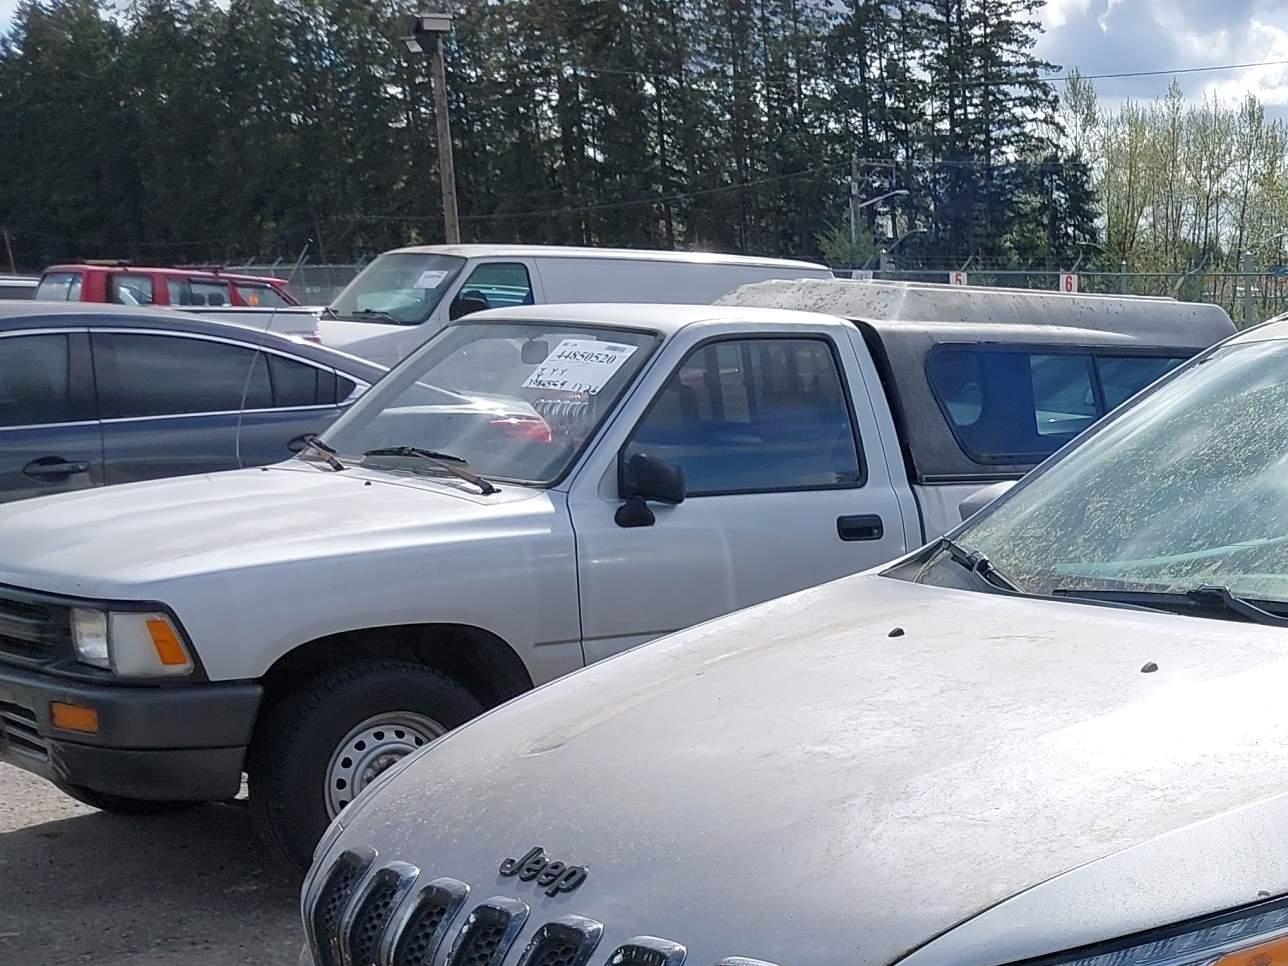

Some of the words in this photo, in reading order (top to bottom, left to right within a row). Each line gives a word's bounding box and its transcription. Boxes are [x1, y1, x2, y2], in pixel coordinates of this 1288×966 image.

[1065, 275, 1073, 292] 6
[556, 350, 617, 364] 44850520
[499, 846, 588, 897] Jeep
